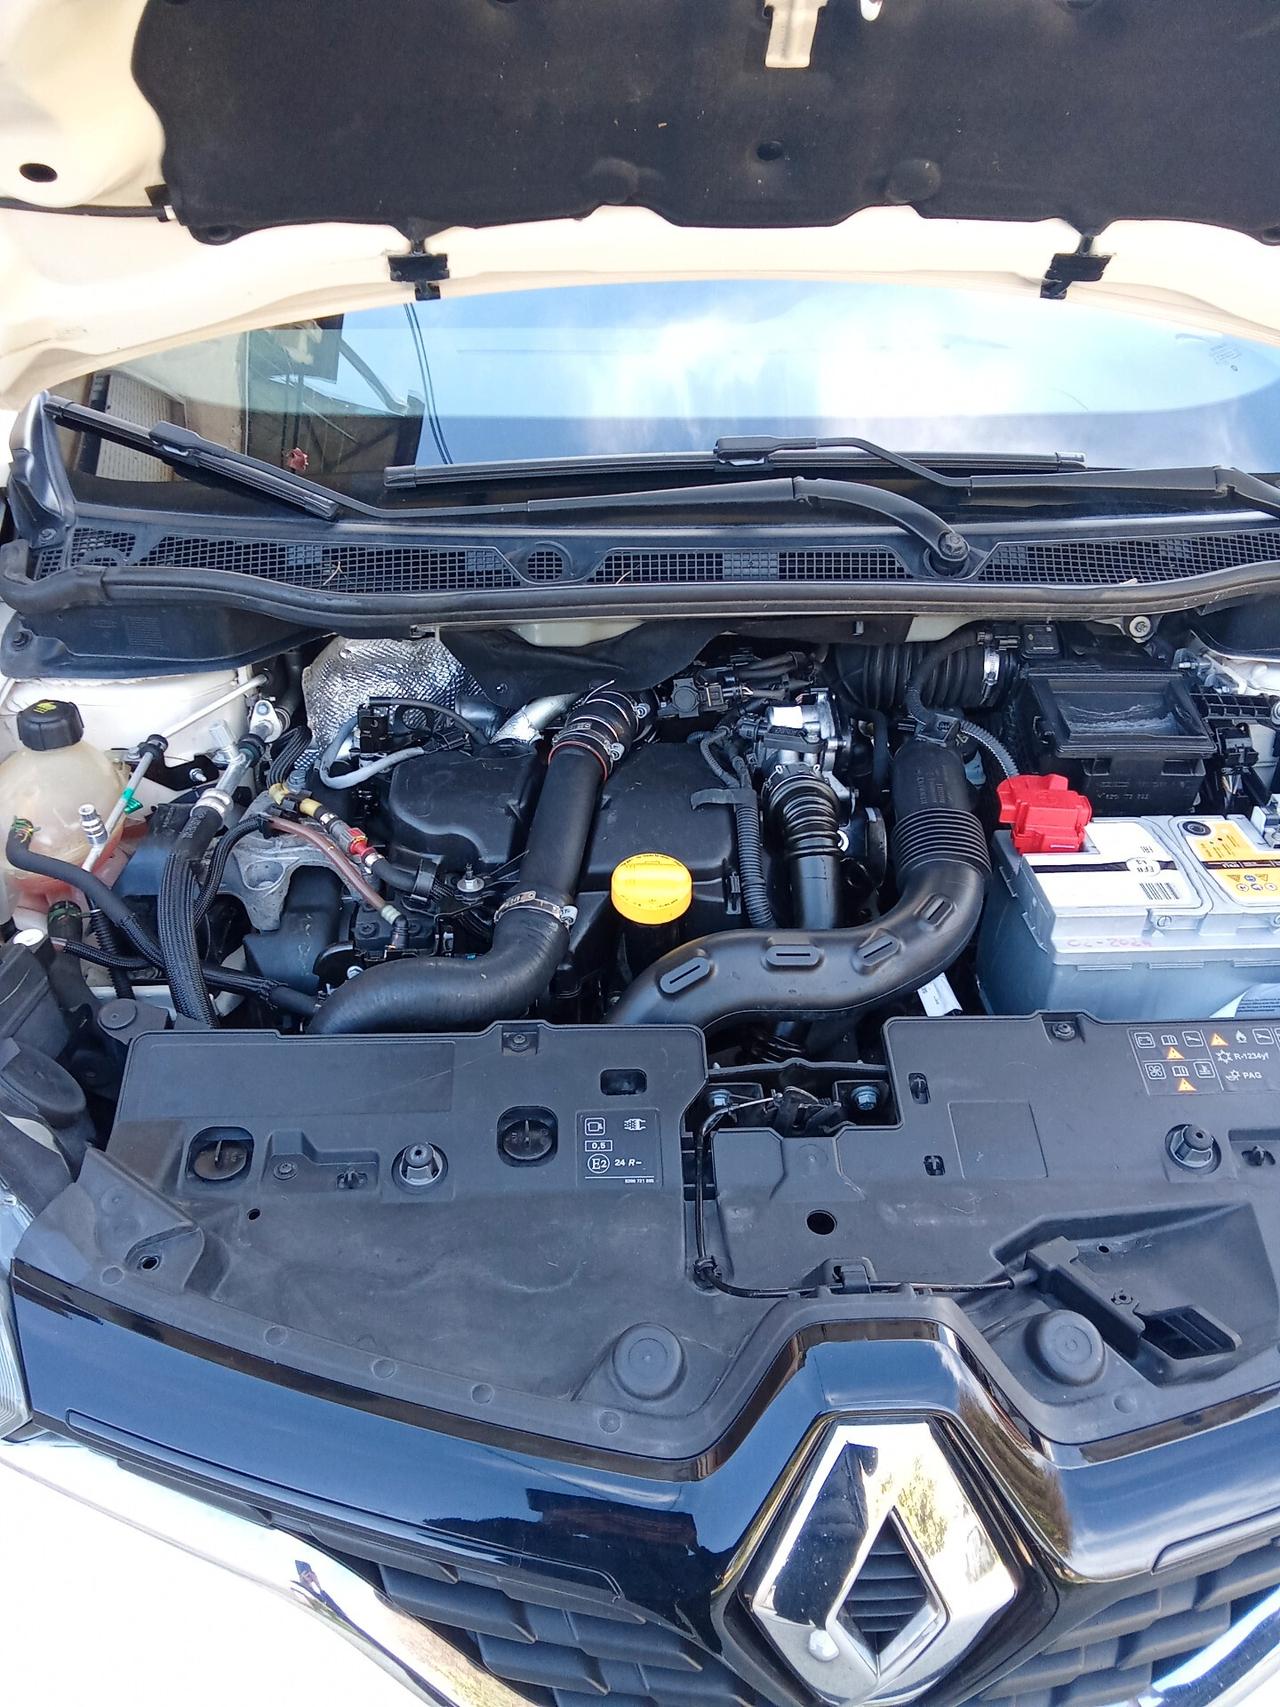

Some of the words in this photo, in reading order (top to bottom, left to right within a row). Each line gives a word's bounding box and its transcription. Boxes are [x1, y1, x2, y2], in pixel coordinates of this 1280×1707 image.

[1242, 1071, 1263, 1080] PAG
[591, 1142, 606, 1150] 0,5
[591, 1158, 608, 1170] E2
